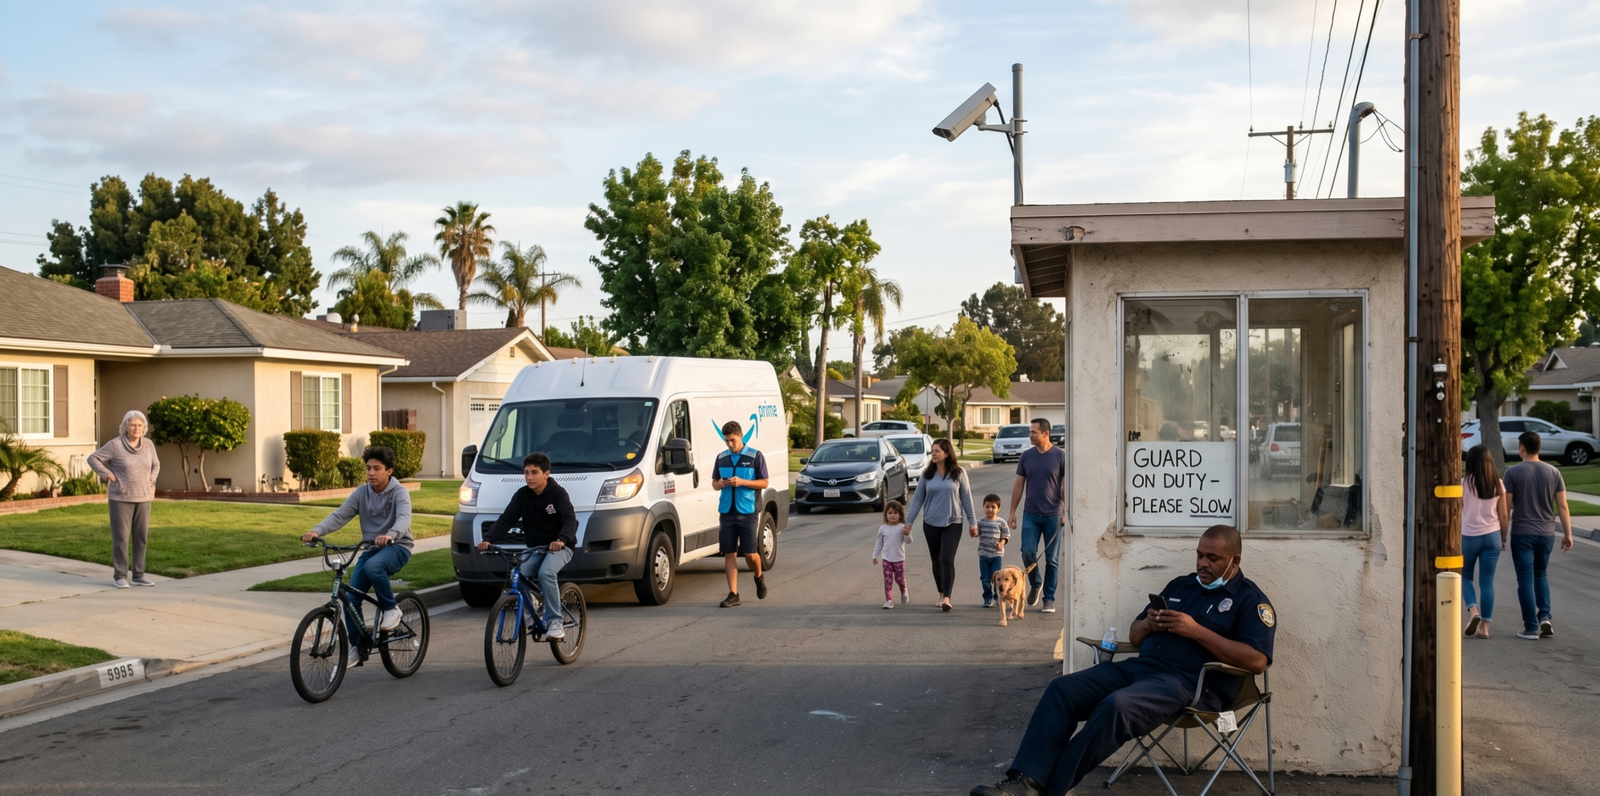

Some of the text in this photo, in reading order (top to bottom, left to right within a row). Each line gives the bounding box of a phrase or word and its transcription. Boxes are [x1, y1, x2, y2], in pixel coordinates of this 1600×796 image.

[758, 400, 778, 422] prime
[1133, 448, 1202, 468] GUARD
[1132, 473, 1155, 488] ON
[1132, 496, 1232, 514] PLEASE SLOW
[107, 663, 134, 681] 5995
